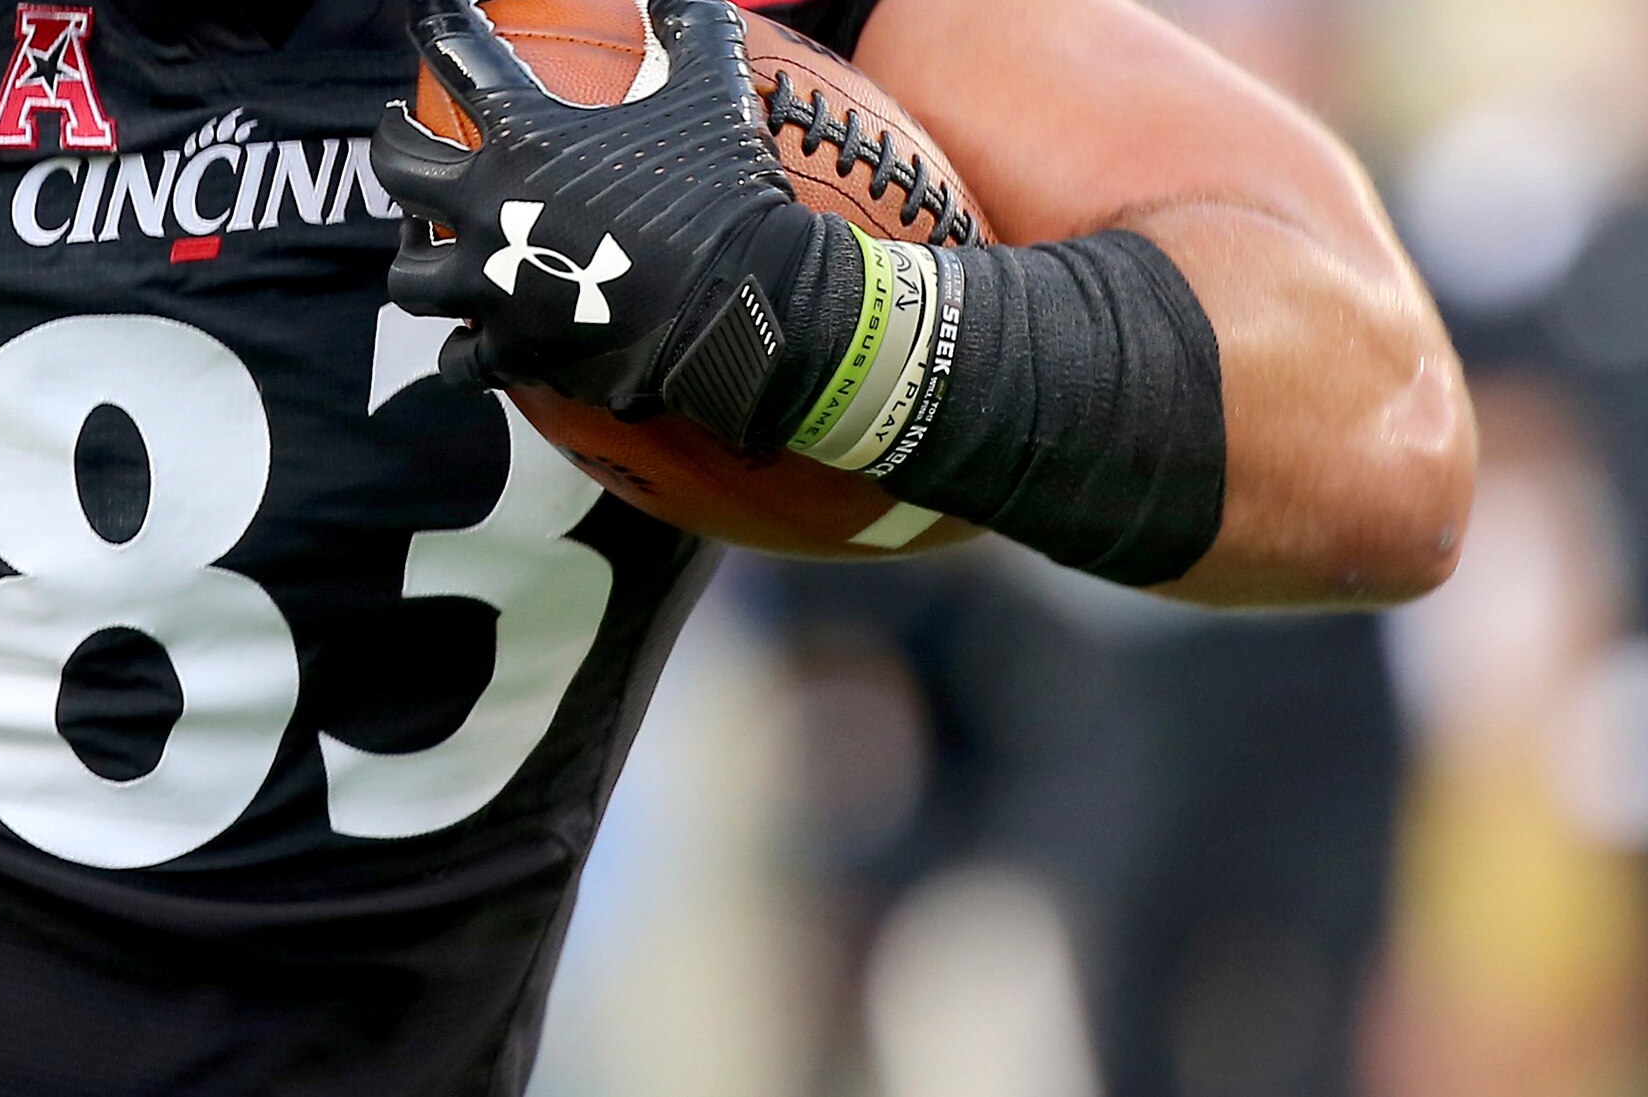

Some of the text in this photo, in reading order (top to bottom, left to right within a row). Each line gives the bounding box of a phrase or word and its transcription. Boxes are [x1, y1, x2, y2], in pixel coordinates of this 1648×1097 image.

[11, 132, 403, 247] CINCINN
[872, 246, 884, 268] IN
[853, 278, 887, 367] JESUS
[932, 304, 960, 375] SEEK
[805, 378, 855, 436] NAME
[876, 381, 919, 443] PLAY
[925, 401, 939, 422] YOU
